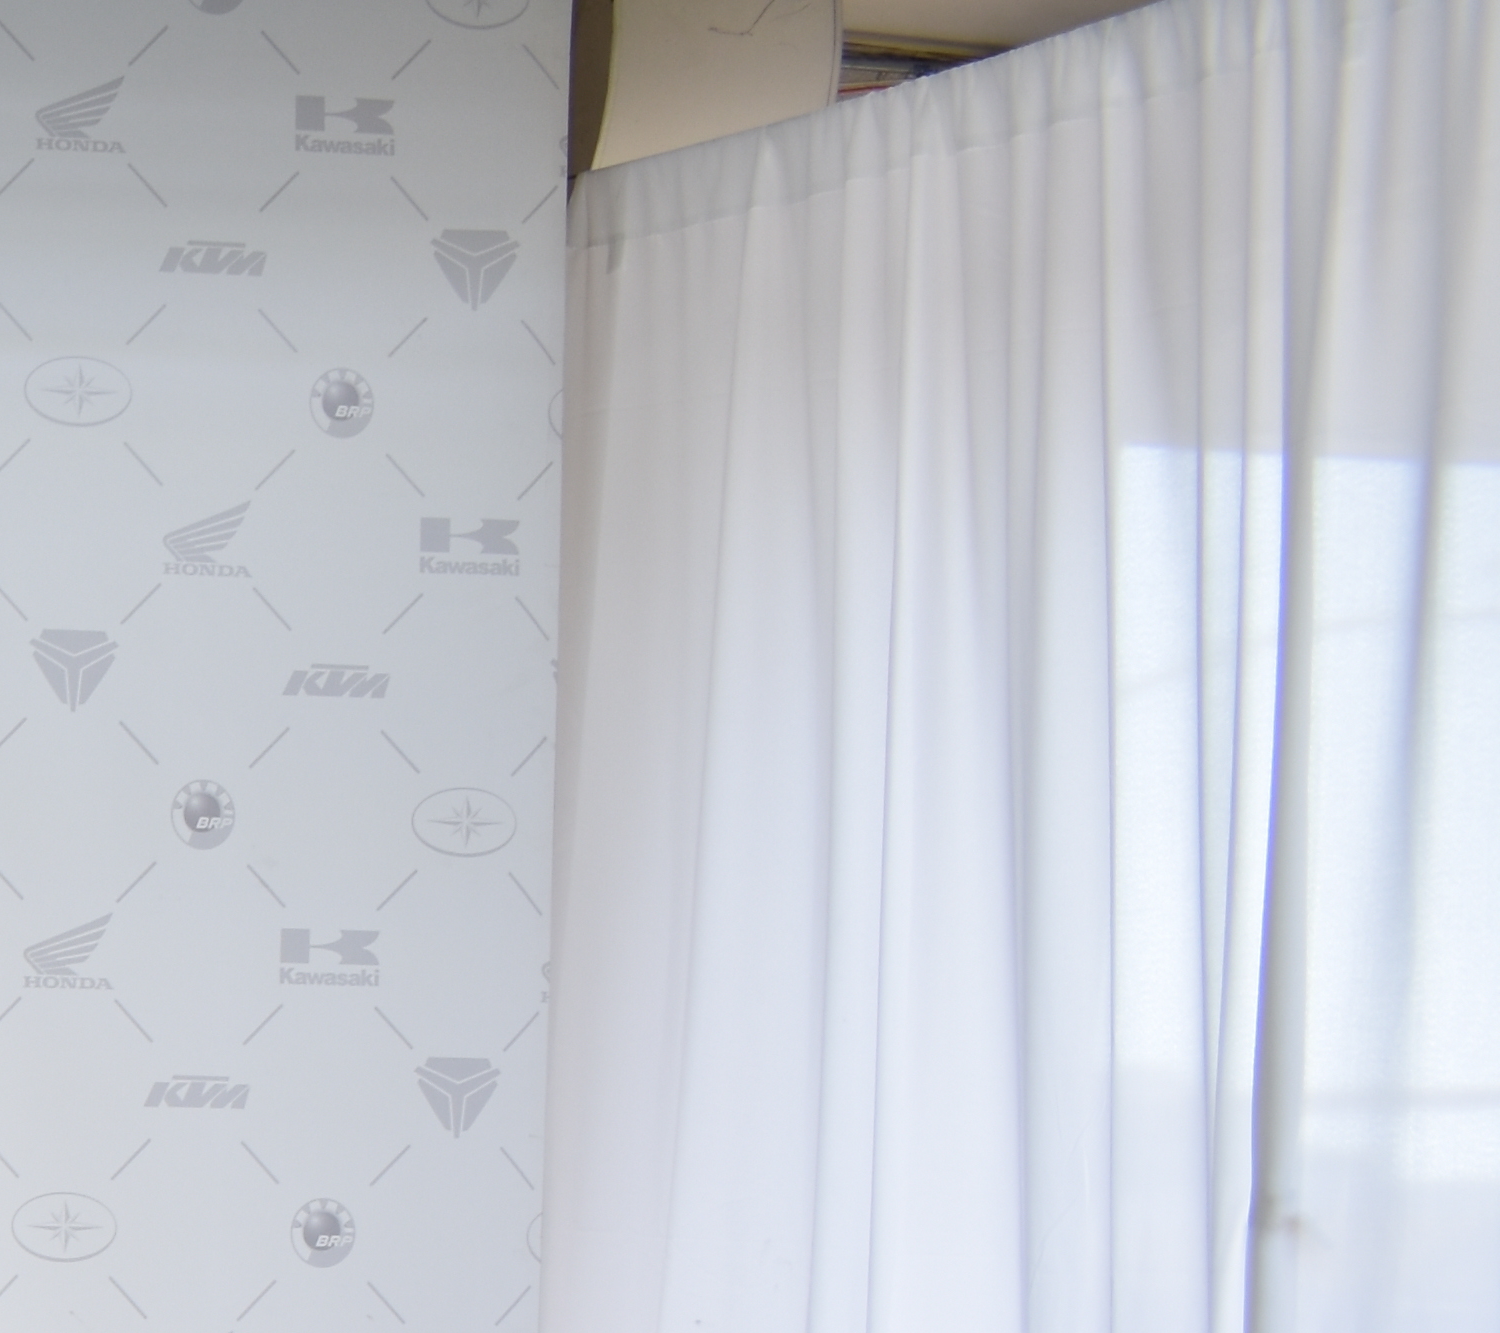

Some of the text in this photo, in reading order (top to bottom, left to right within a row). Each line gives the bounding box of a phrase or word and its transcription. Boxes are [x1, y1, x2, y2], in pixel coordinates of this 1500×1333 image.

[37, 137, 126, 153] HONDA
[295, 133, 395, 156] Kawasaki
[160, 240, 267, 276] KTM
[336, 405, 370, 418] BRP
[164, 561, 252, 578] HONDA
[420, 555, 520, 577] Kawasaki
[283, 664, 390, 698] KTM
[24, 974, 113, 990] HONDA
[280, 965, 380, 986] Kawasaki
[144, 1075, 250, 1109] KTM
[317, 1234, 351, 1247] BRP
